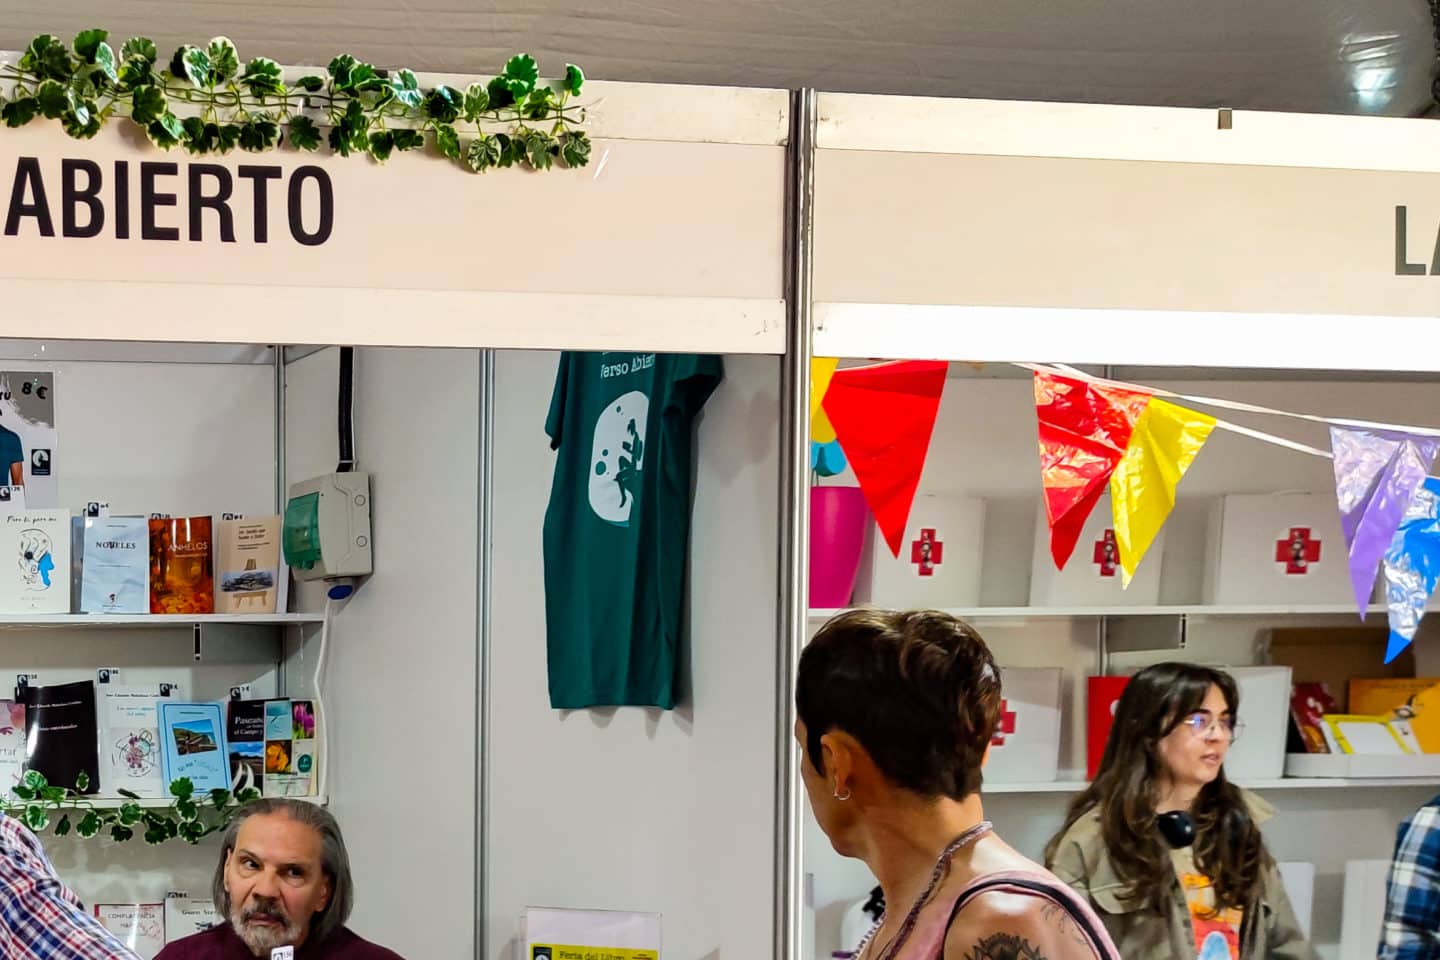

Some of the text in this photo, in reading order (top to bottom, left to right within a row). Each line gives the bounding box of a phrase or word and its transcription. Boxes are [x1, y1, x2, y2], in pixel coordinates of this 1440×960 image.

[5, 156, 336, 247] ABIERTO
[1395, 205, 1440, 275] L
[631, 354, 656, 373] Abier
[21, 382, 48, 399] 8 €
